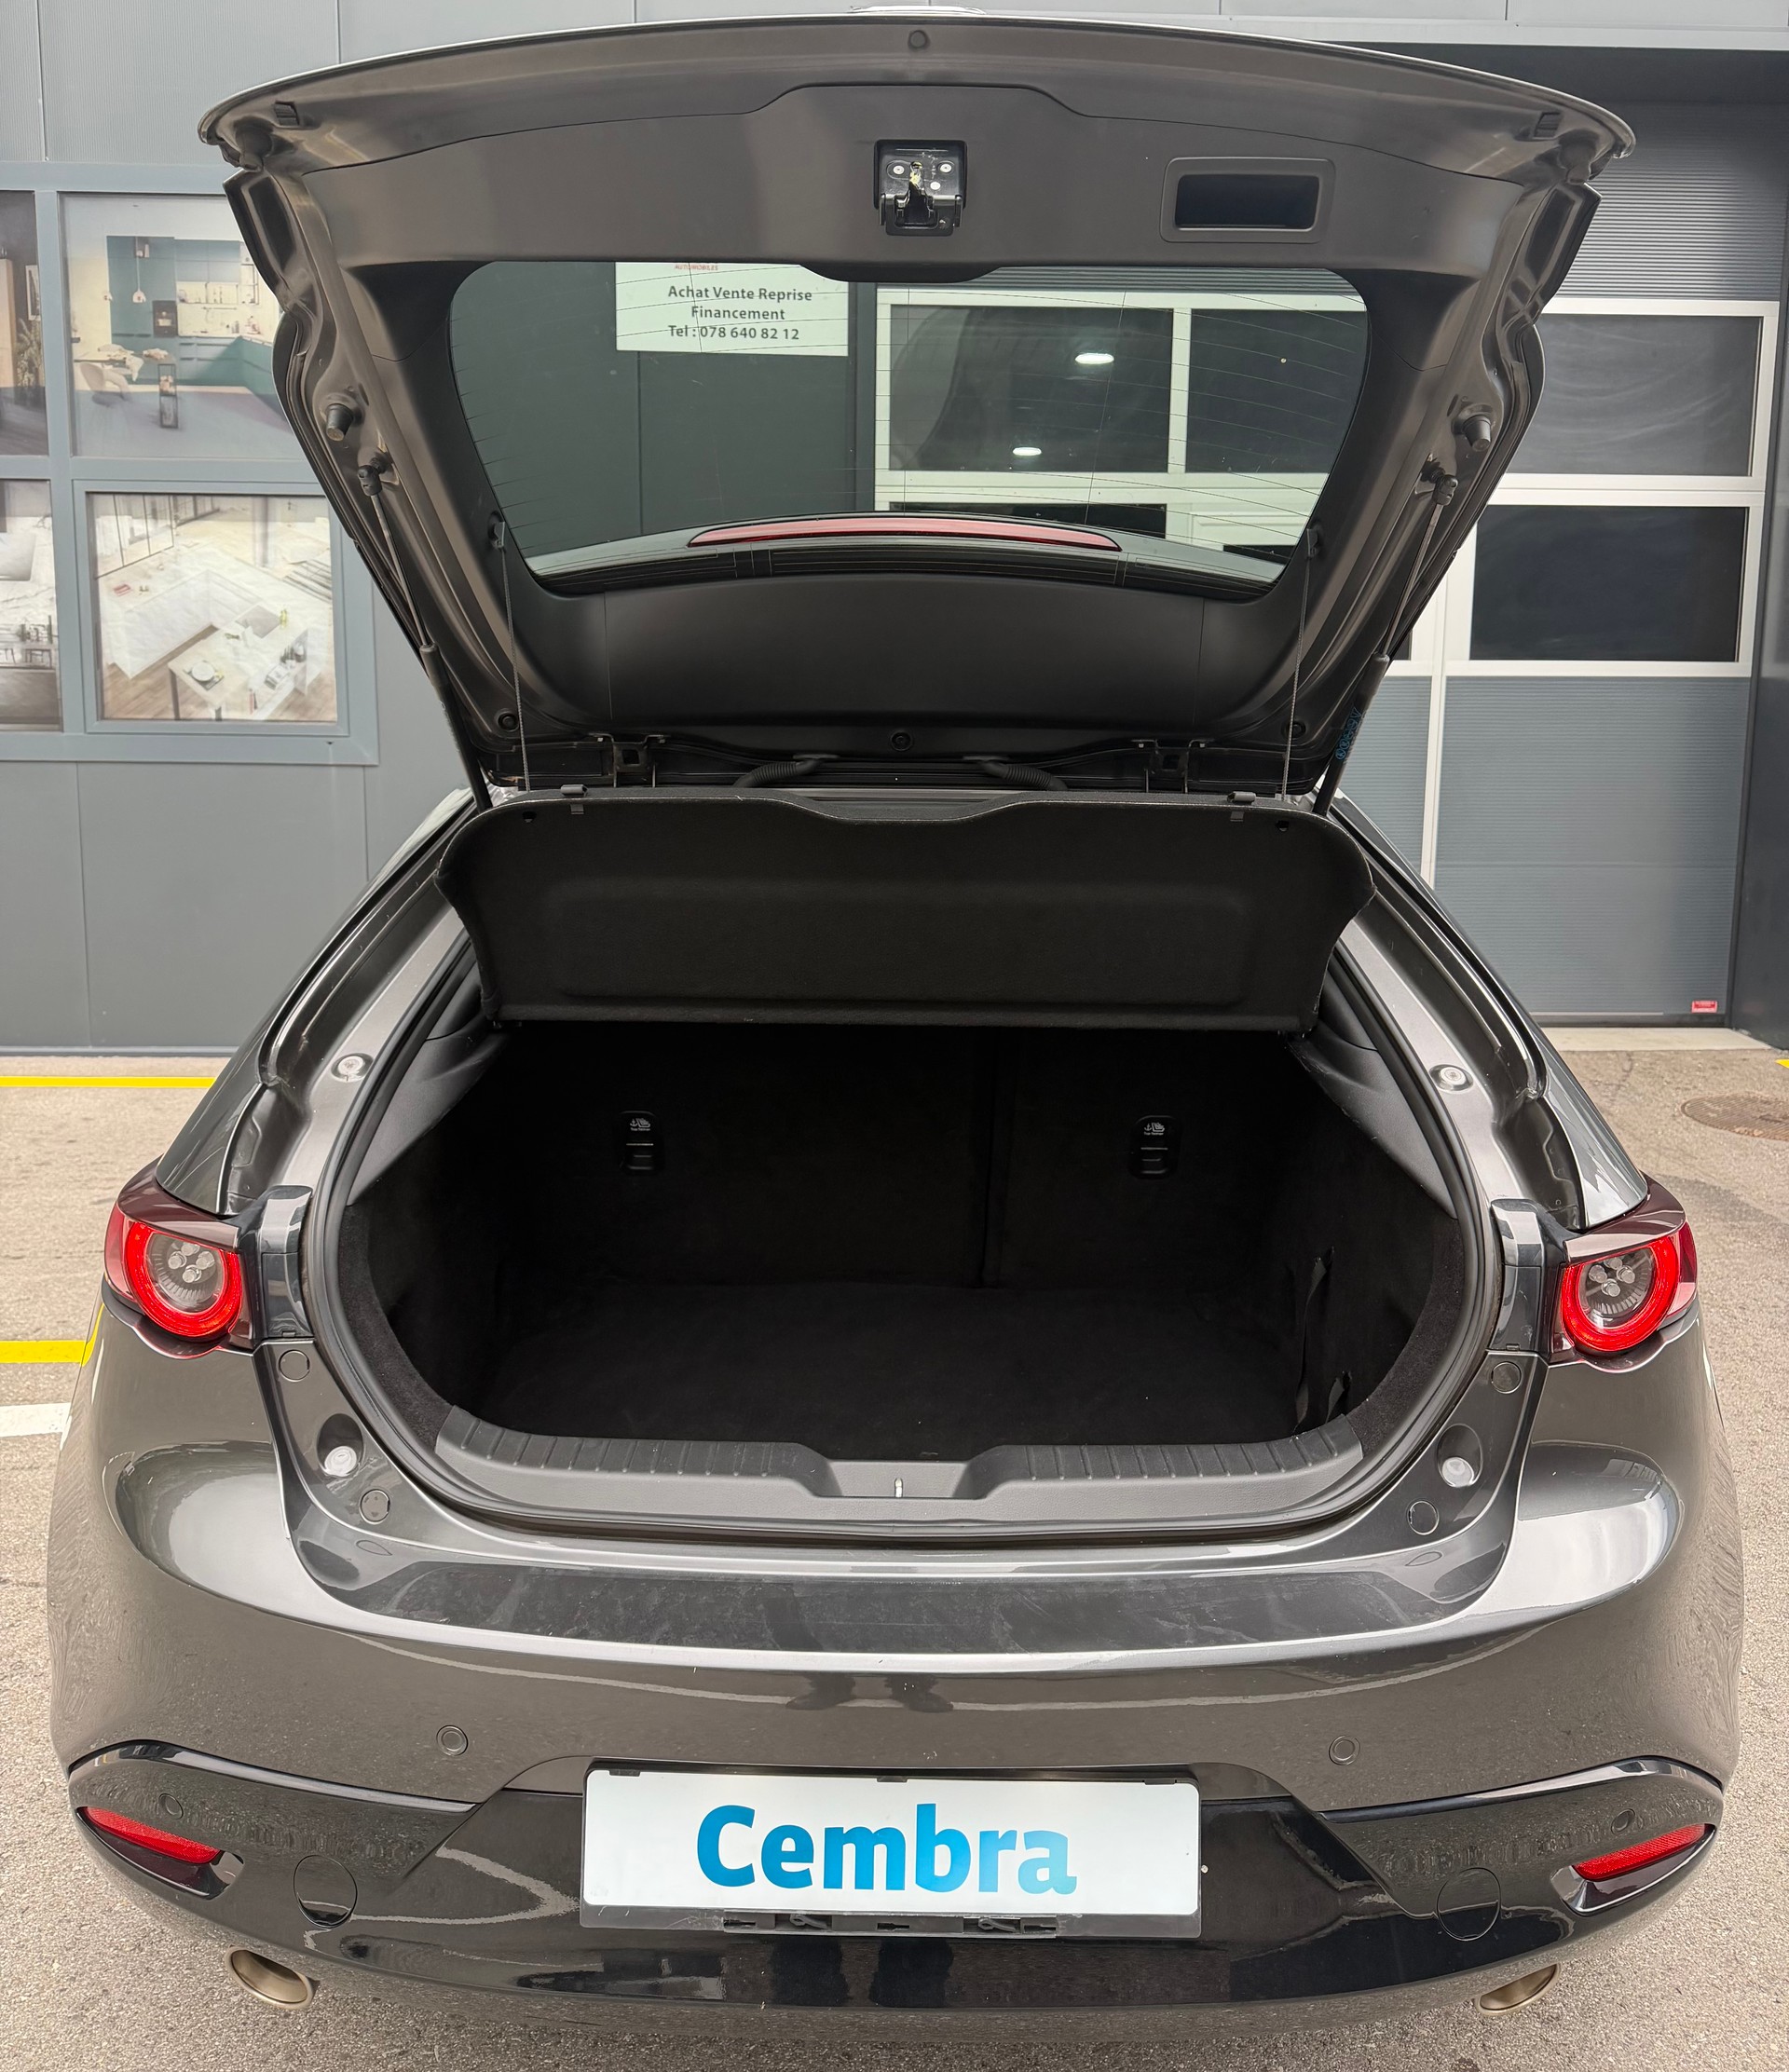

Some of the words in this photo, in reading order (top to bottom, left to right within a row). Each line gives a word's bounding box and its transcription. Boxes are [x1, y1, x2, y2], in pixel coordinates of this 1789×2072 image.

[668, 285, 709, 298] Achat
[713, 286, 755, 299] Vente
[758, 288, 813, 303] Reprise
[691, 307, 785, 320] Financement
[668, 325, 689, 337] Tel
[700, 326, 726, 338] 078
[731, 327, 757, 340] 640
[760, 328, 778, 340] 82
[784, 329, 799, 340] 12
[697, 1803, 1077, 1895] Cembra
